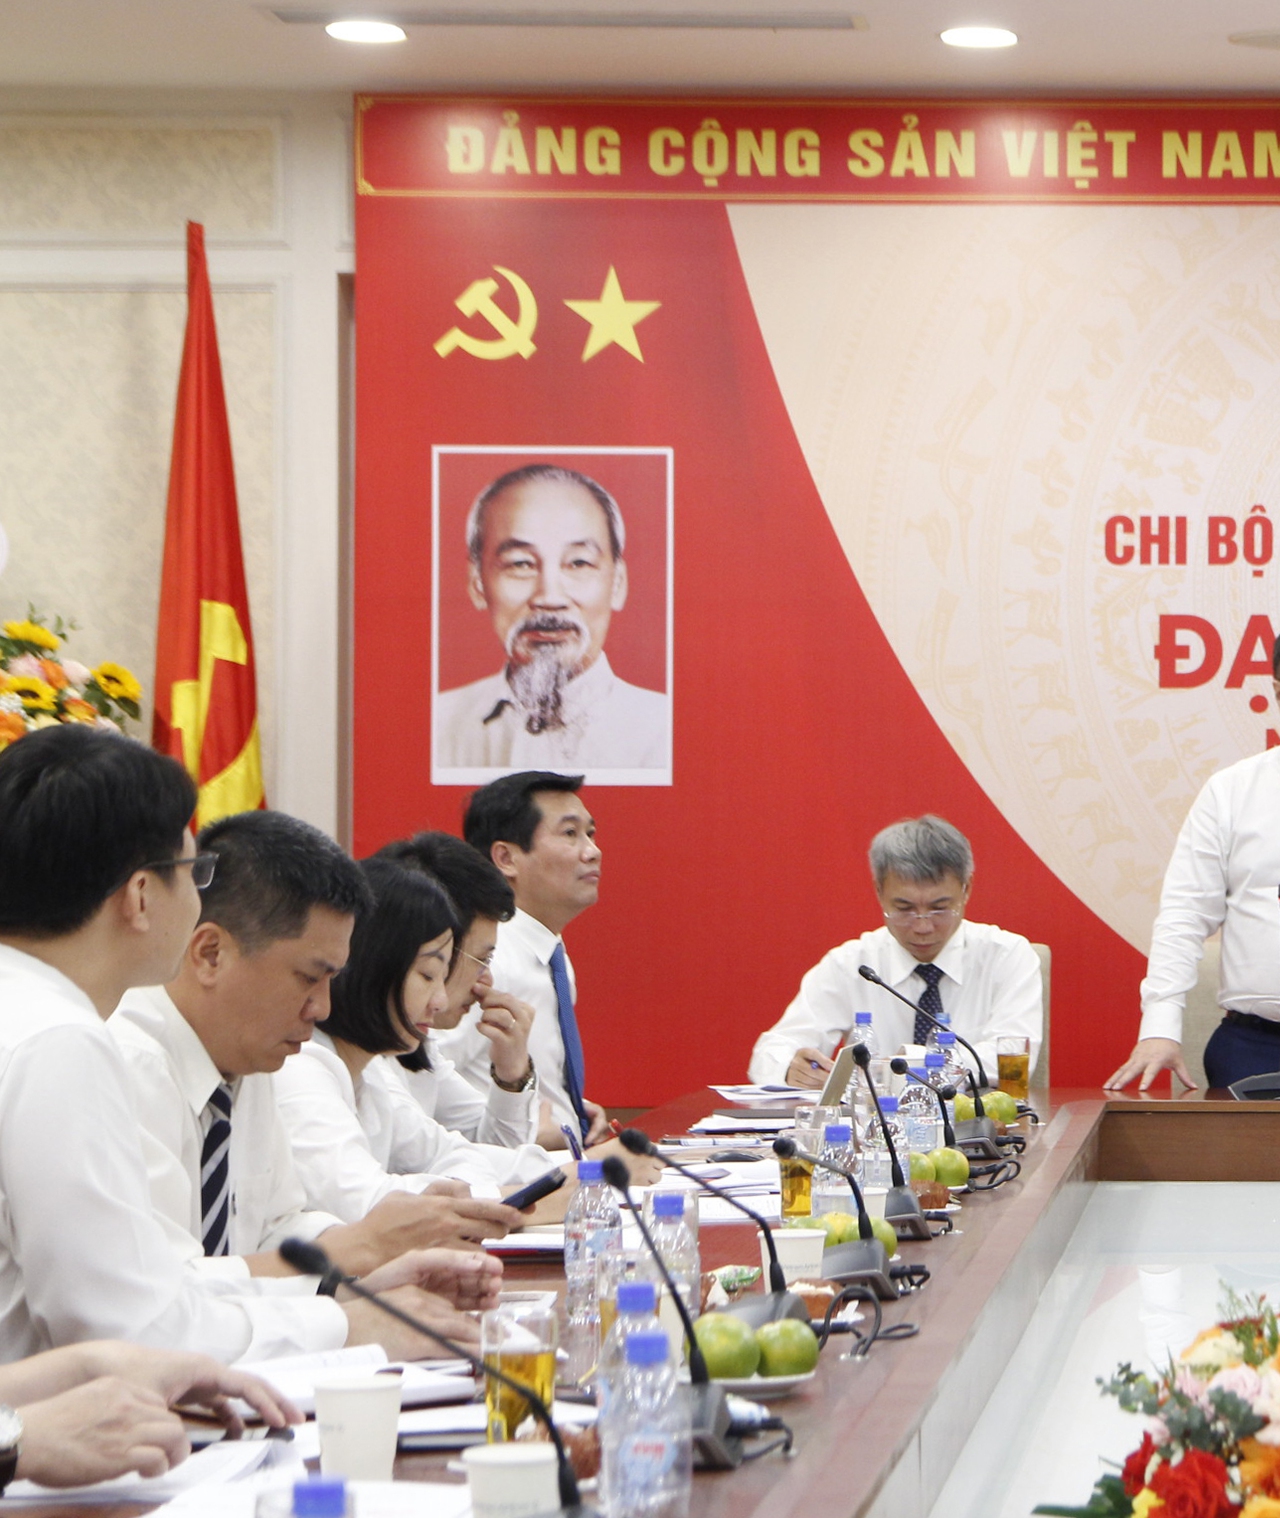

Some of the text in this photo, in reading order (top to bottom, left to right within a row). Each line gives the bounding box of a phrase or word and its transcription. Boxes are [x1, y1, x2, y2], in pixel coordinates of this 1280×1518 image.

[445, 111, 622, 176] ĐẢNG
[648, 120, 821, 187] CỘNG
[847, 115, 978, 178] SẢN
[1003, 119, 1136, 189] VIỆT
[1104, 515, 1188, 566] CHI
[1208, 504, 1274, 577] BỘ
